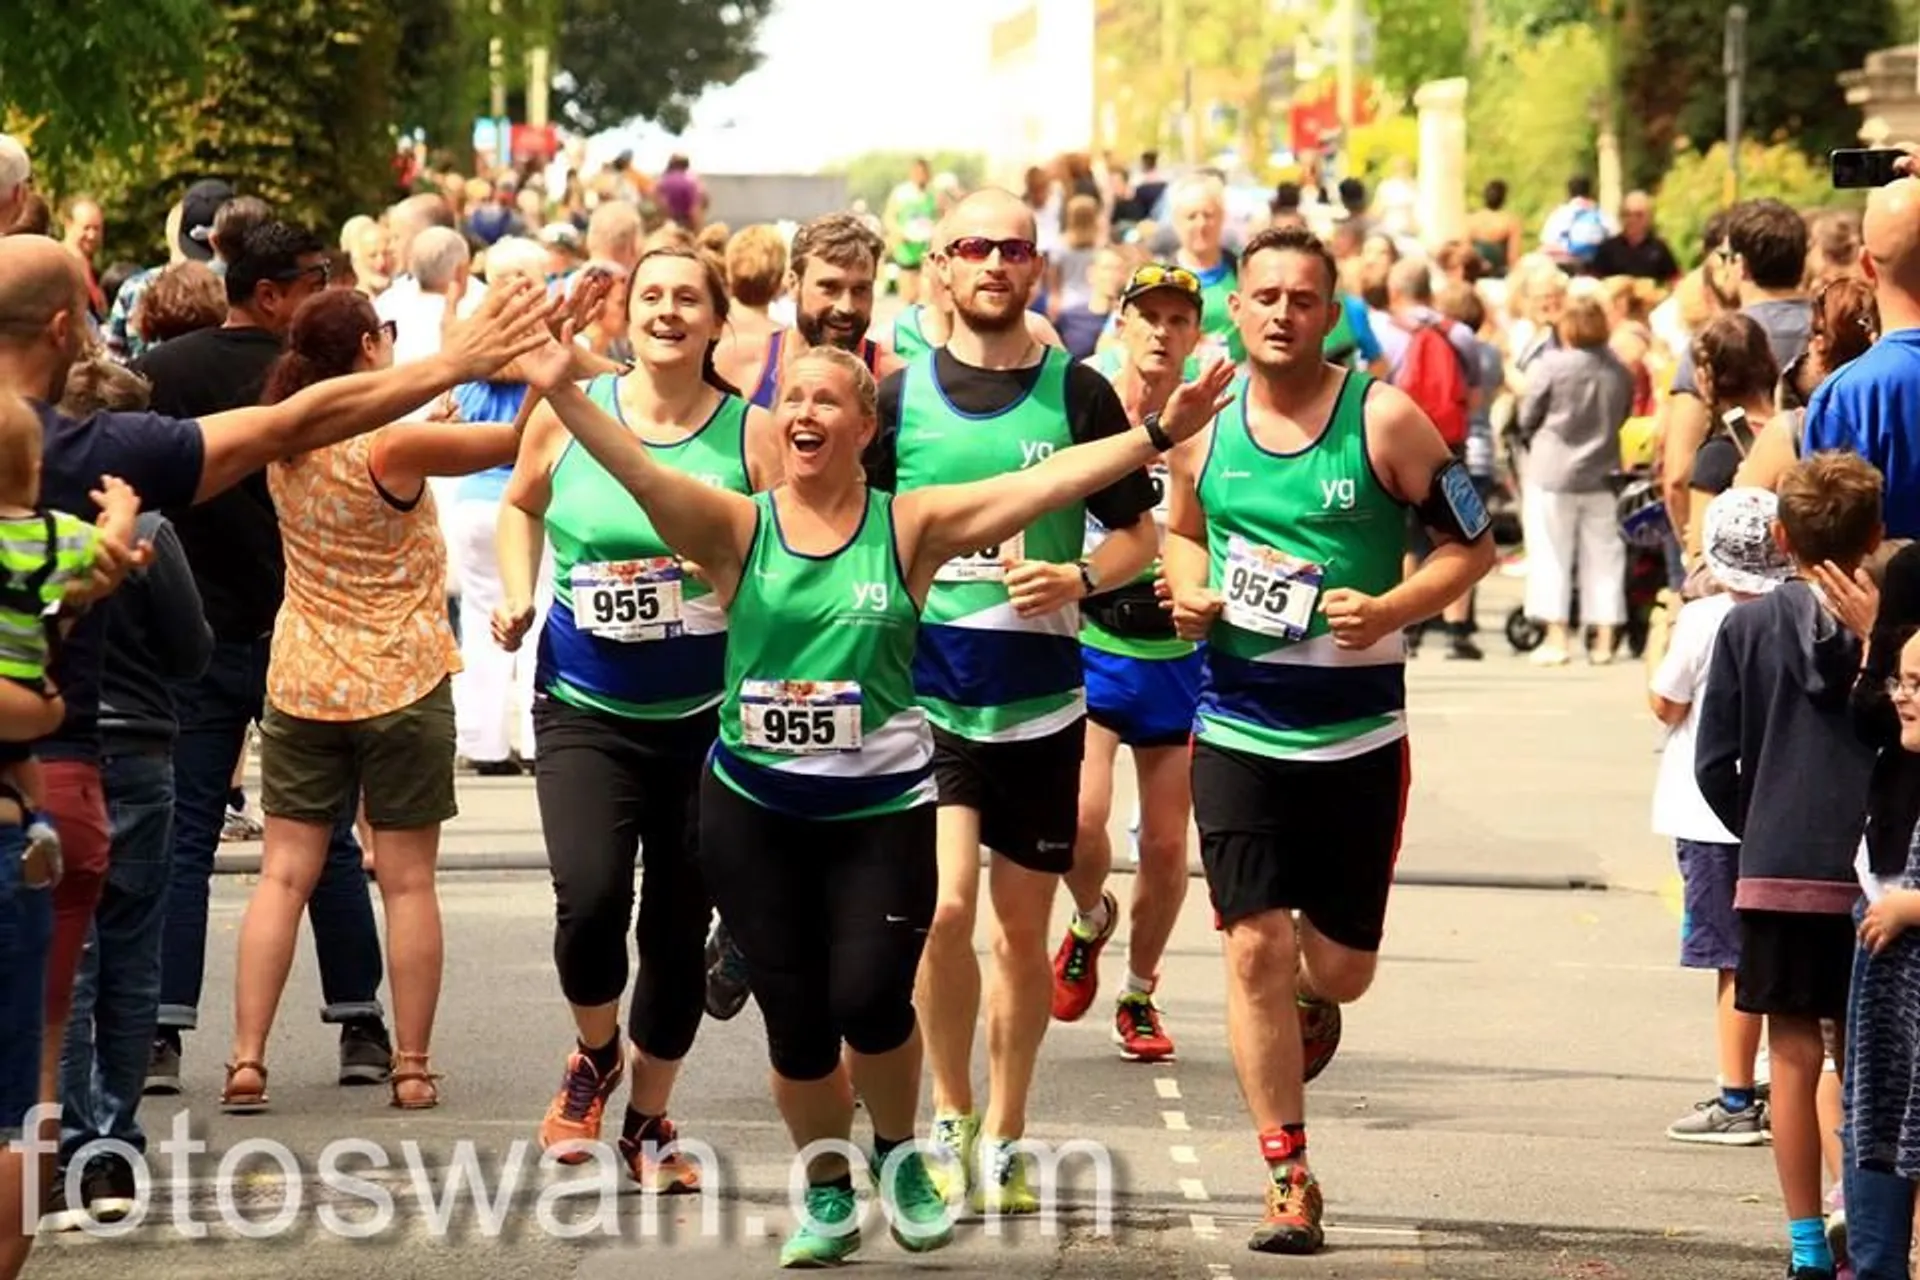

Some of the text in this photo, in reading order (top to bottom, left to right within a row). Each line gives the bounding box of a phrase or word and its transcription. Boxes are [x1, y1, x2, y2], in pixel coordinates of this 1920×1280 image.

[1320, 478, 1355, 509] yg
[593, 586, 659, 623] 955
[852, 582, 887, 612] yg
[1229, 566, 1291, 614] 955
[763, 708, 835, 745] 955
